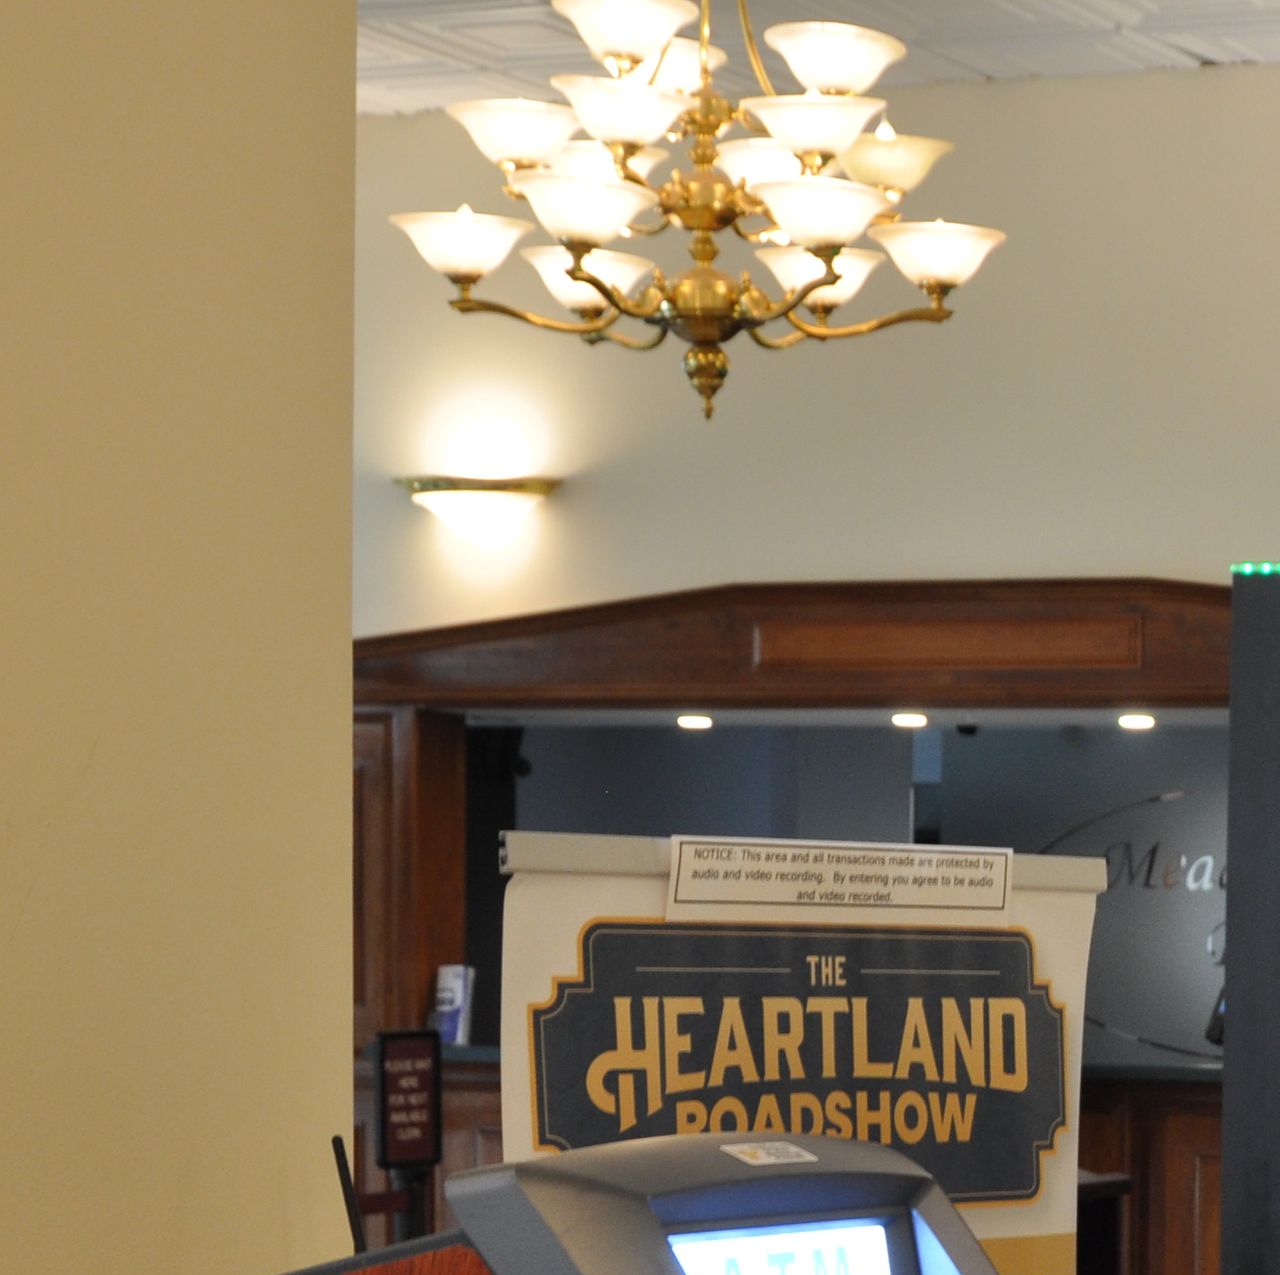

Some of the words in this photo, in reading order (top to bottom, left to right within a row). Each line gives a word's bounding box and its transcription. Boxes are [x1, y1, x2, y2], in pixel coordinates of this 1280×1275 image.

[742, 848, 761, 862] This
[764, 853, 787, 863] area
[790, 851, 809, 864] and
[812, 852, 824, 864] all
[827, 853, 886, 866] transactions
[888, 855, 915, 867] made
[918, 859, 934, 868] are
[936, 857, 980, 871] protected
[982, 858, 995, 872] by
[691, 868, 720, 880] audio
[722, 869, 741, 881] and
[744, 869, 772, 882] video
[832, 871, 846, 885] By
[849, 873, 889, 887] entering
[891, 876, 909, 887] you
[912, 877, 939, 888] agree
[941, 875, 951, 886] to
[953, 875, 966, 887] be
[968, 876, 995, 888] audio
[796, 890, 816, 901] and
[818, 890, 846, 902] video
[806, 954, 848, 987] THE
[585, 995, 1029, 1133] HEARTLAND
[675, 1089, 978, 1145] ROADSHOW
